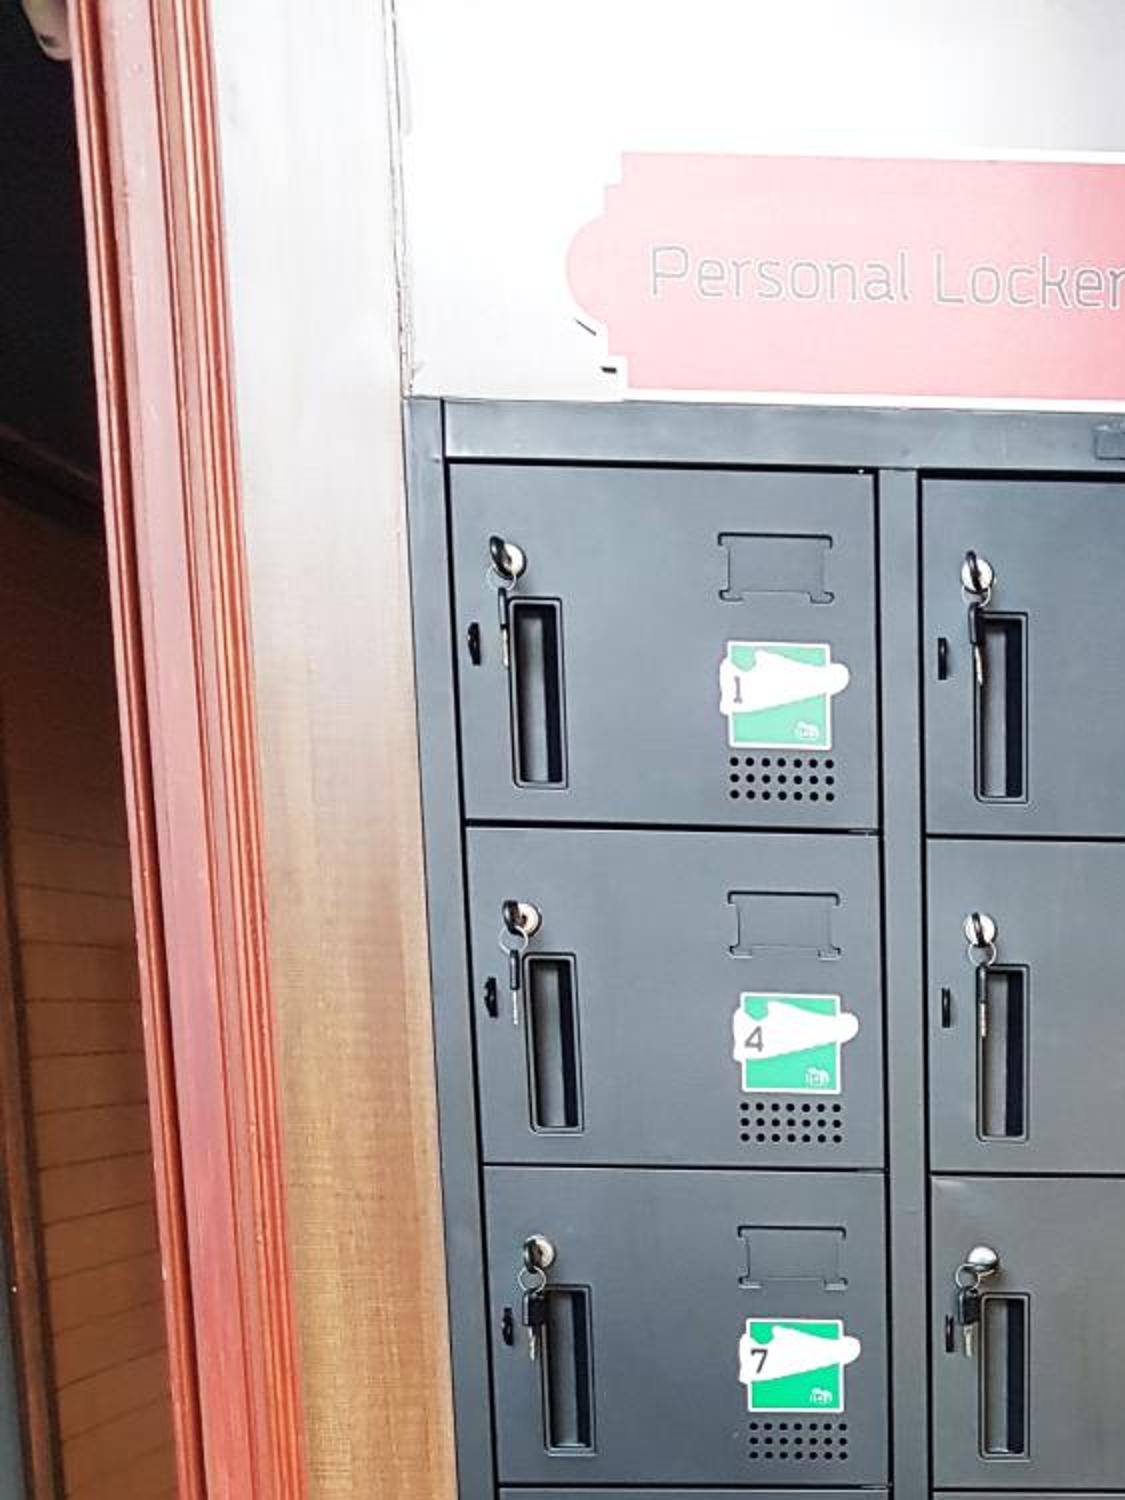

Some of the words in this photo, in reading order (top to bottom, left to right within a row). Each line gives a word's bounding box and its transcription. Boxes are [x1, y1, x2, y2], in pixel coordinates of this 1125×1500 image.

[651, 245, 909, 302] Personal
[733, 675, 744, 704] 1
[744, 1026, 763, 1052] 4
[750, 1348, 768, 1374] 7
